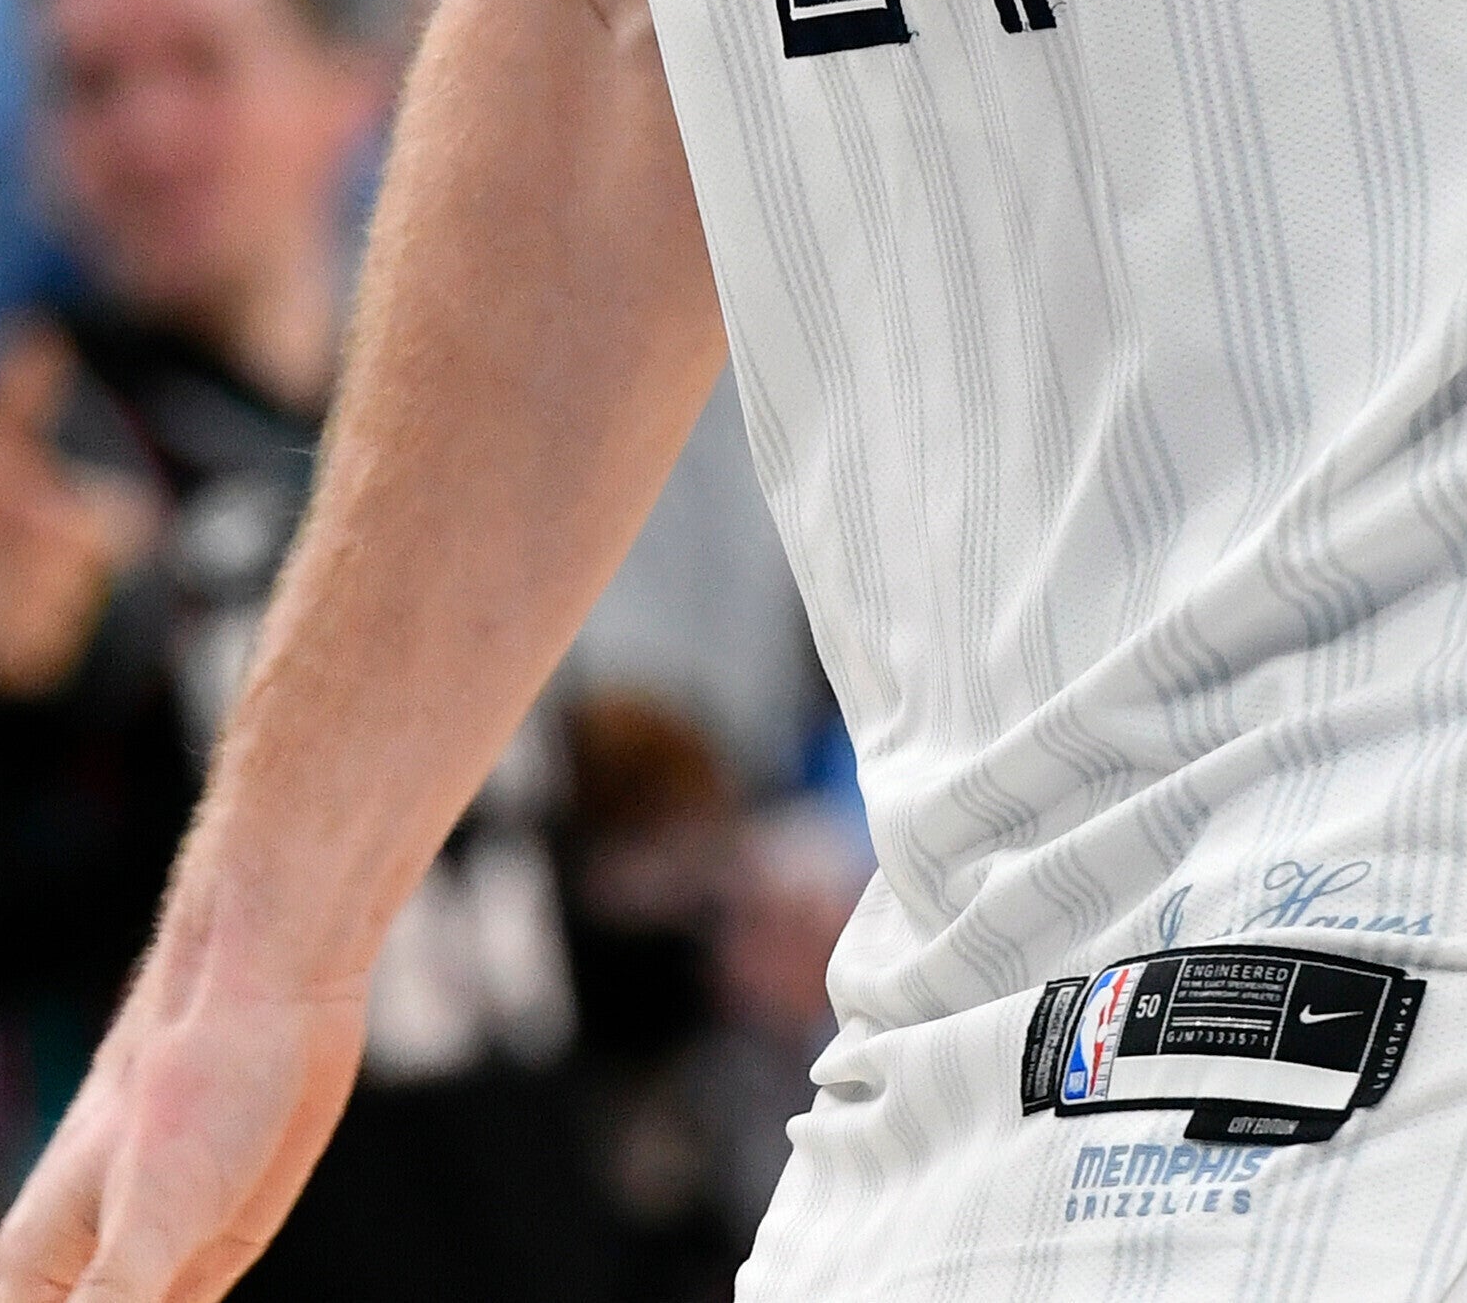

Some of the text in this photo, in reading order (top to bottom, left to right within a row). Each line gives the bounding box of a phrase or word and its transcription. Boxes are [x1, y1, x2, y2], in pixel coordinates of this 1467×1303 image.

[1183, 964, 1290, 982] ENGINEERED
[1135, 993, 1161, 1019] 50
[1065, 1190, 1252, 1222] GRIZZLIES
